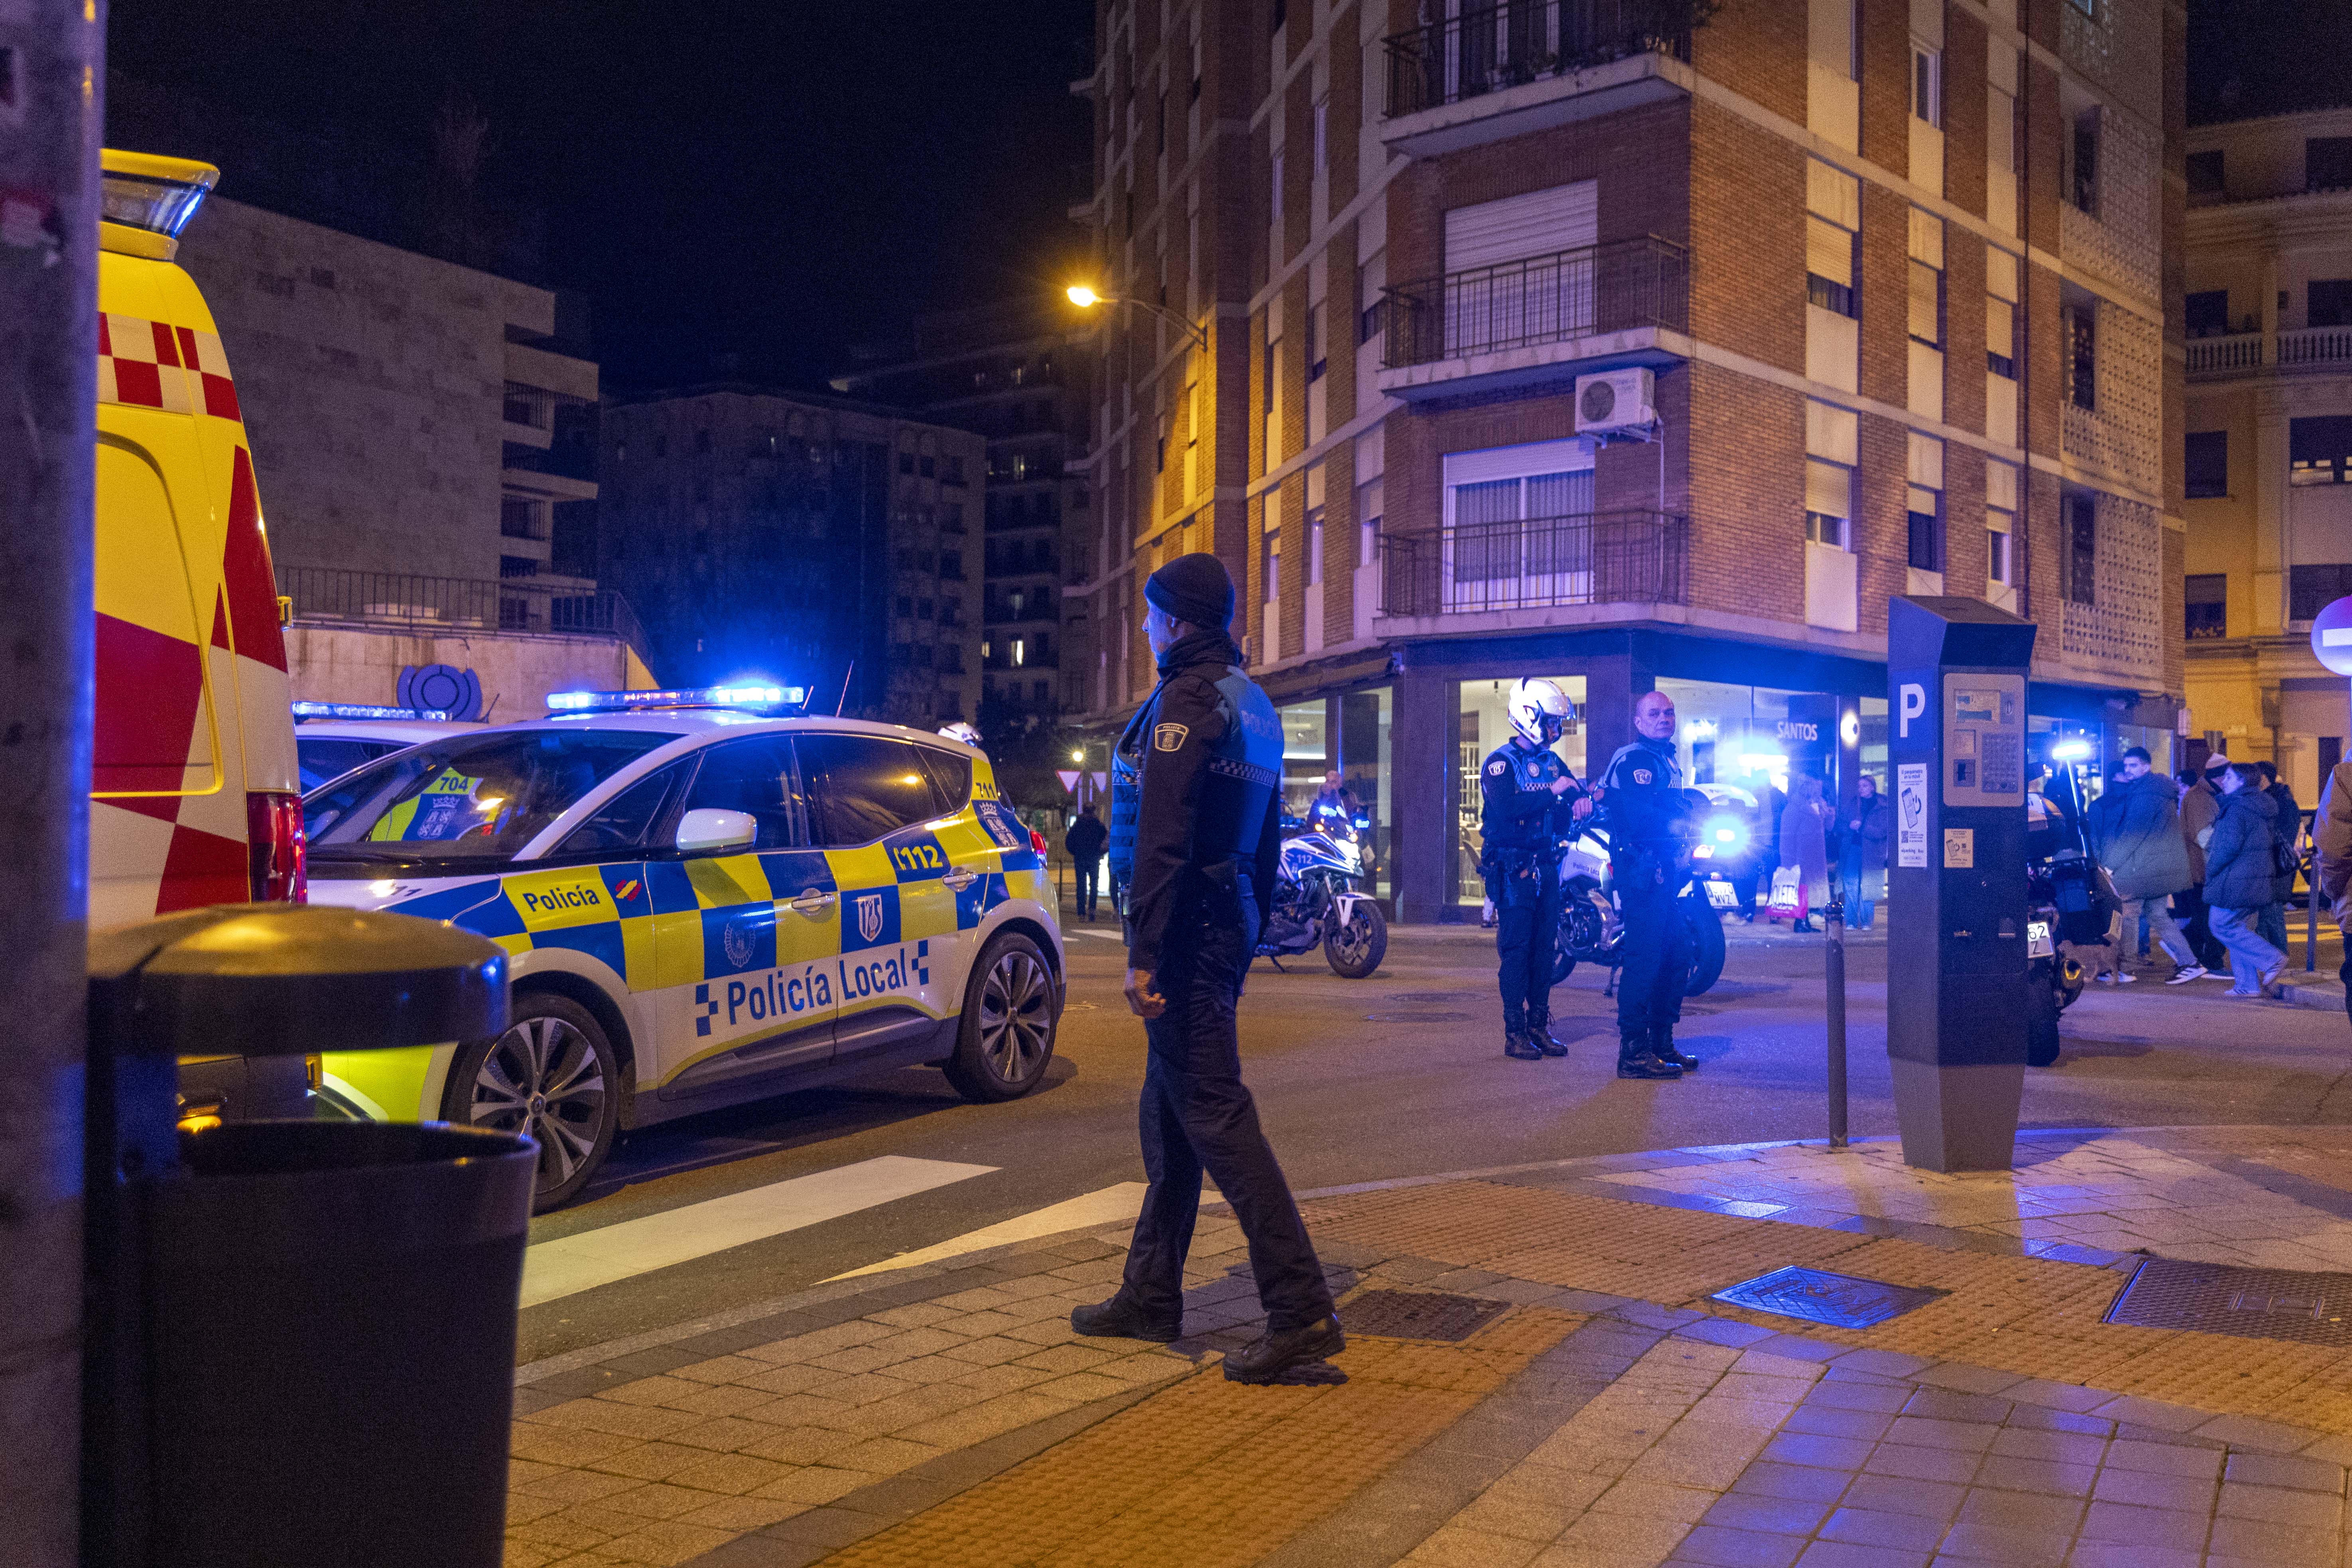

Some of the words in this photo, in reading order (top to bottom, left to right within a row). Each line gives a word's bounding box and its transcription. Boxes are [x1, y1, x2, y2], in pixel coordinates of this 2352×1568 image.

[1900, 683, 1926, 737] P
[1778, 721, 1818, 741] SANTOS
[440, 776, 468, 792] 704
[975, 782, 996, 798] 711
[900, 845, 943, 870] 112
[1297, 854, 1312, 864] 112
[522, 884, 601, 912] Policía
[2029, 926, 2047, 939] 62
[2031, 940, 2040, 953] Z
[727, 965, 833, 1025] Policía
[839, 947, 908, 1001] Local
